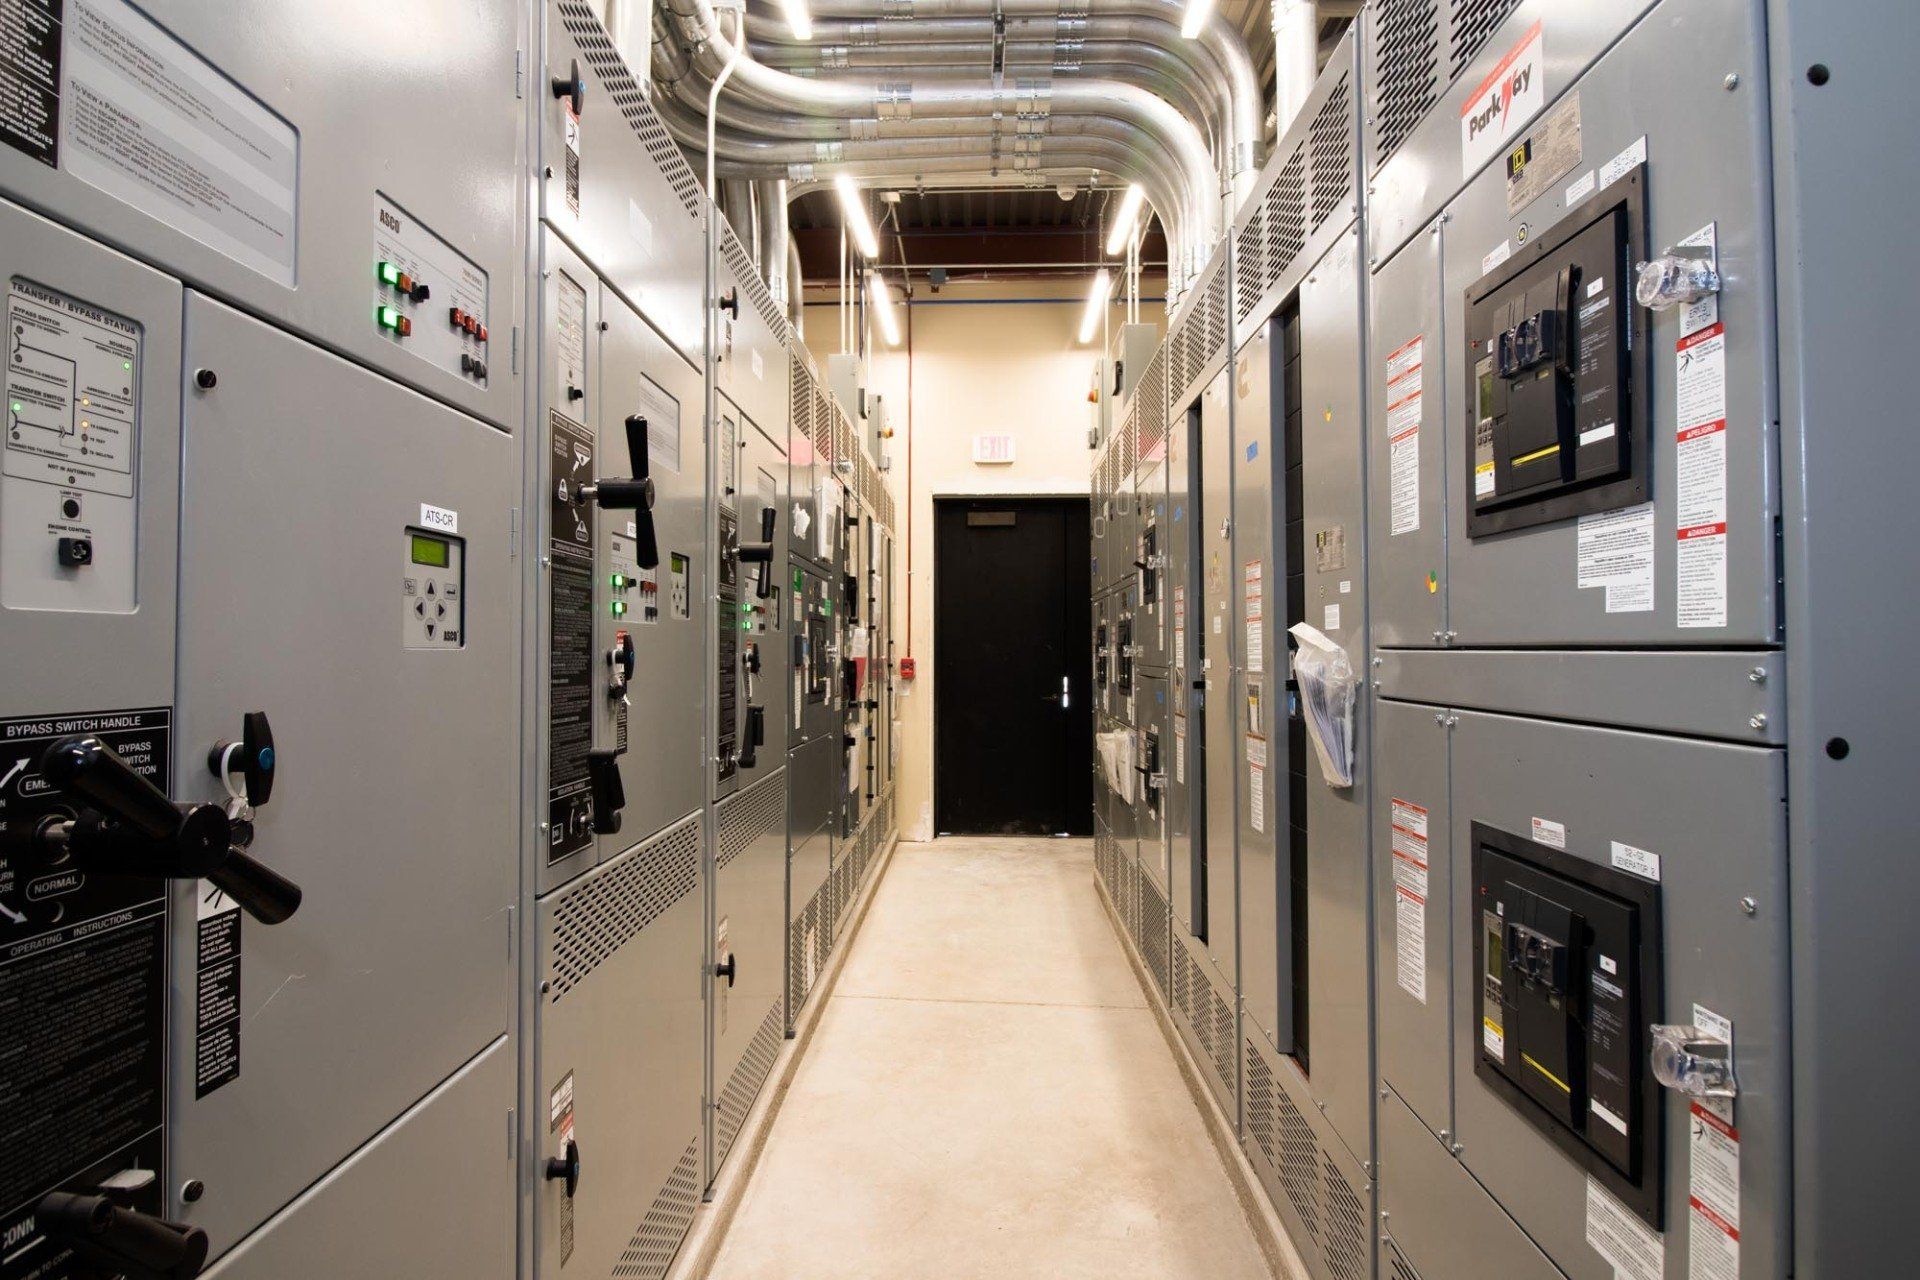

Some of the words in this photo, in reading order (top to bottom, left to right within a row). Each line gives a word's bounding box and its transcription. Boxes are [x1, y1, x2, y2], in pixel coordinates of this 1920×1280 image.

[380, 208, 400, 234] ASCO
[12, 283, 61, 307] TRANSFER
[68, 304, 101, 322] BYPASS
[103, 316, 136, 335] STATUS
[1690, 328, 1715, 344] DANGER
[1691, 424, 1716, 436] PELIGRO
[980, 436, 1010, 459] EXIT
[426, 510, 454, 527] ATS-CR
[1690, 526, 1716, 536] DANGER
[7, 722, 53, 737] BYPASS
[56, 719, 98, 732] SWITCH
[100, 716, 141, 729] HANDLE
[118, 742, 152, 754] BYPASS
[34, 876, 77, 894] NORMAL
[10, 932, 62, 956] OPERATING
[73, 911, 132, 936] INSTRUCTIONS
